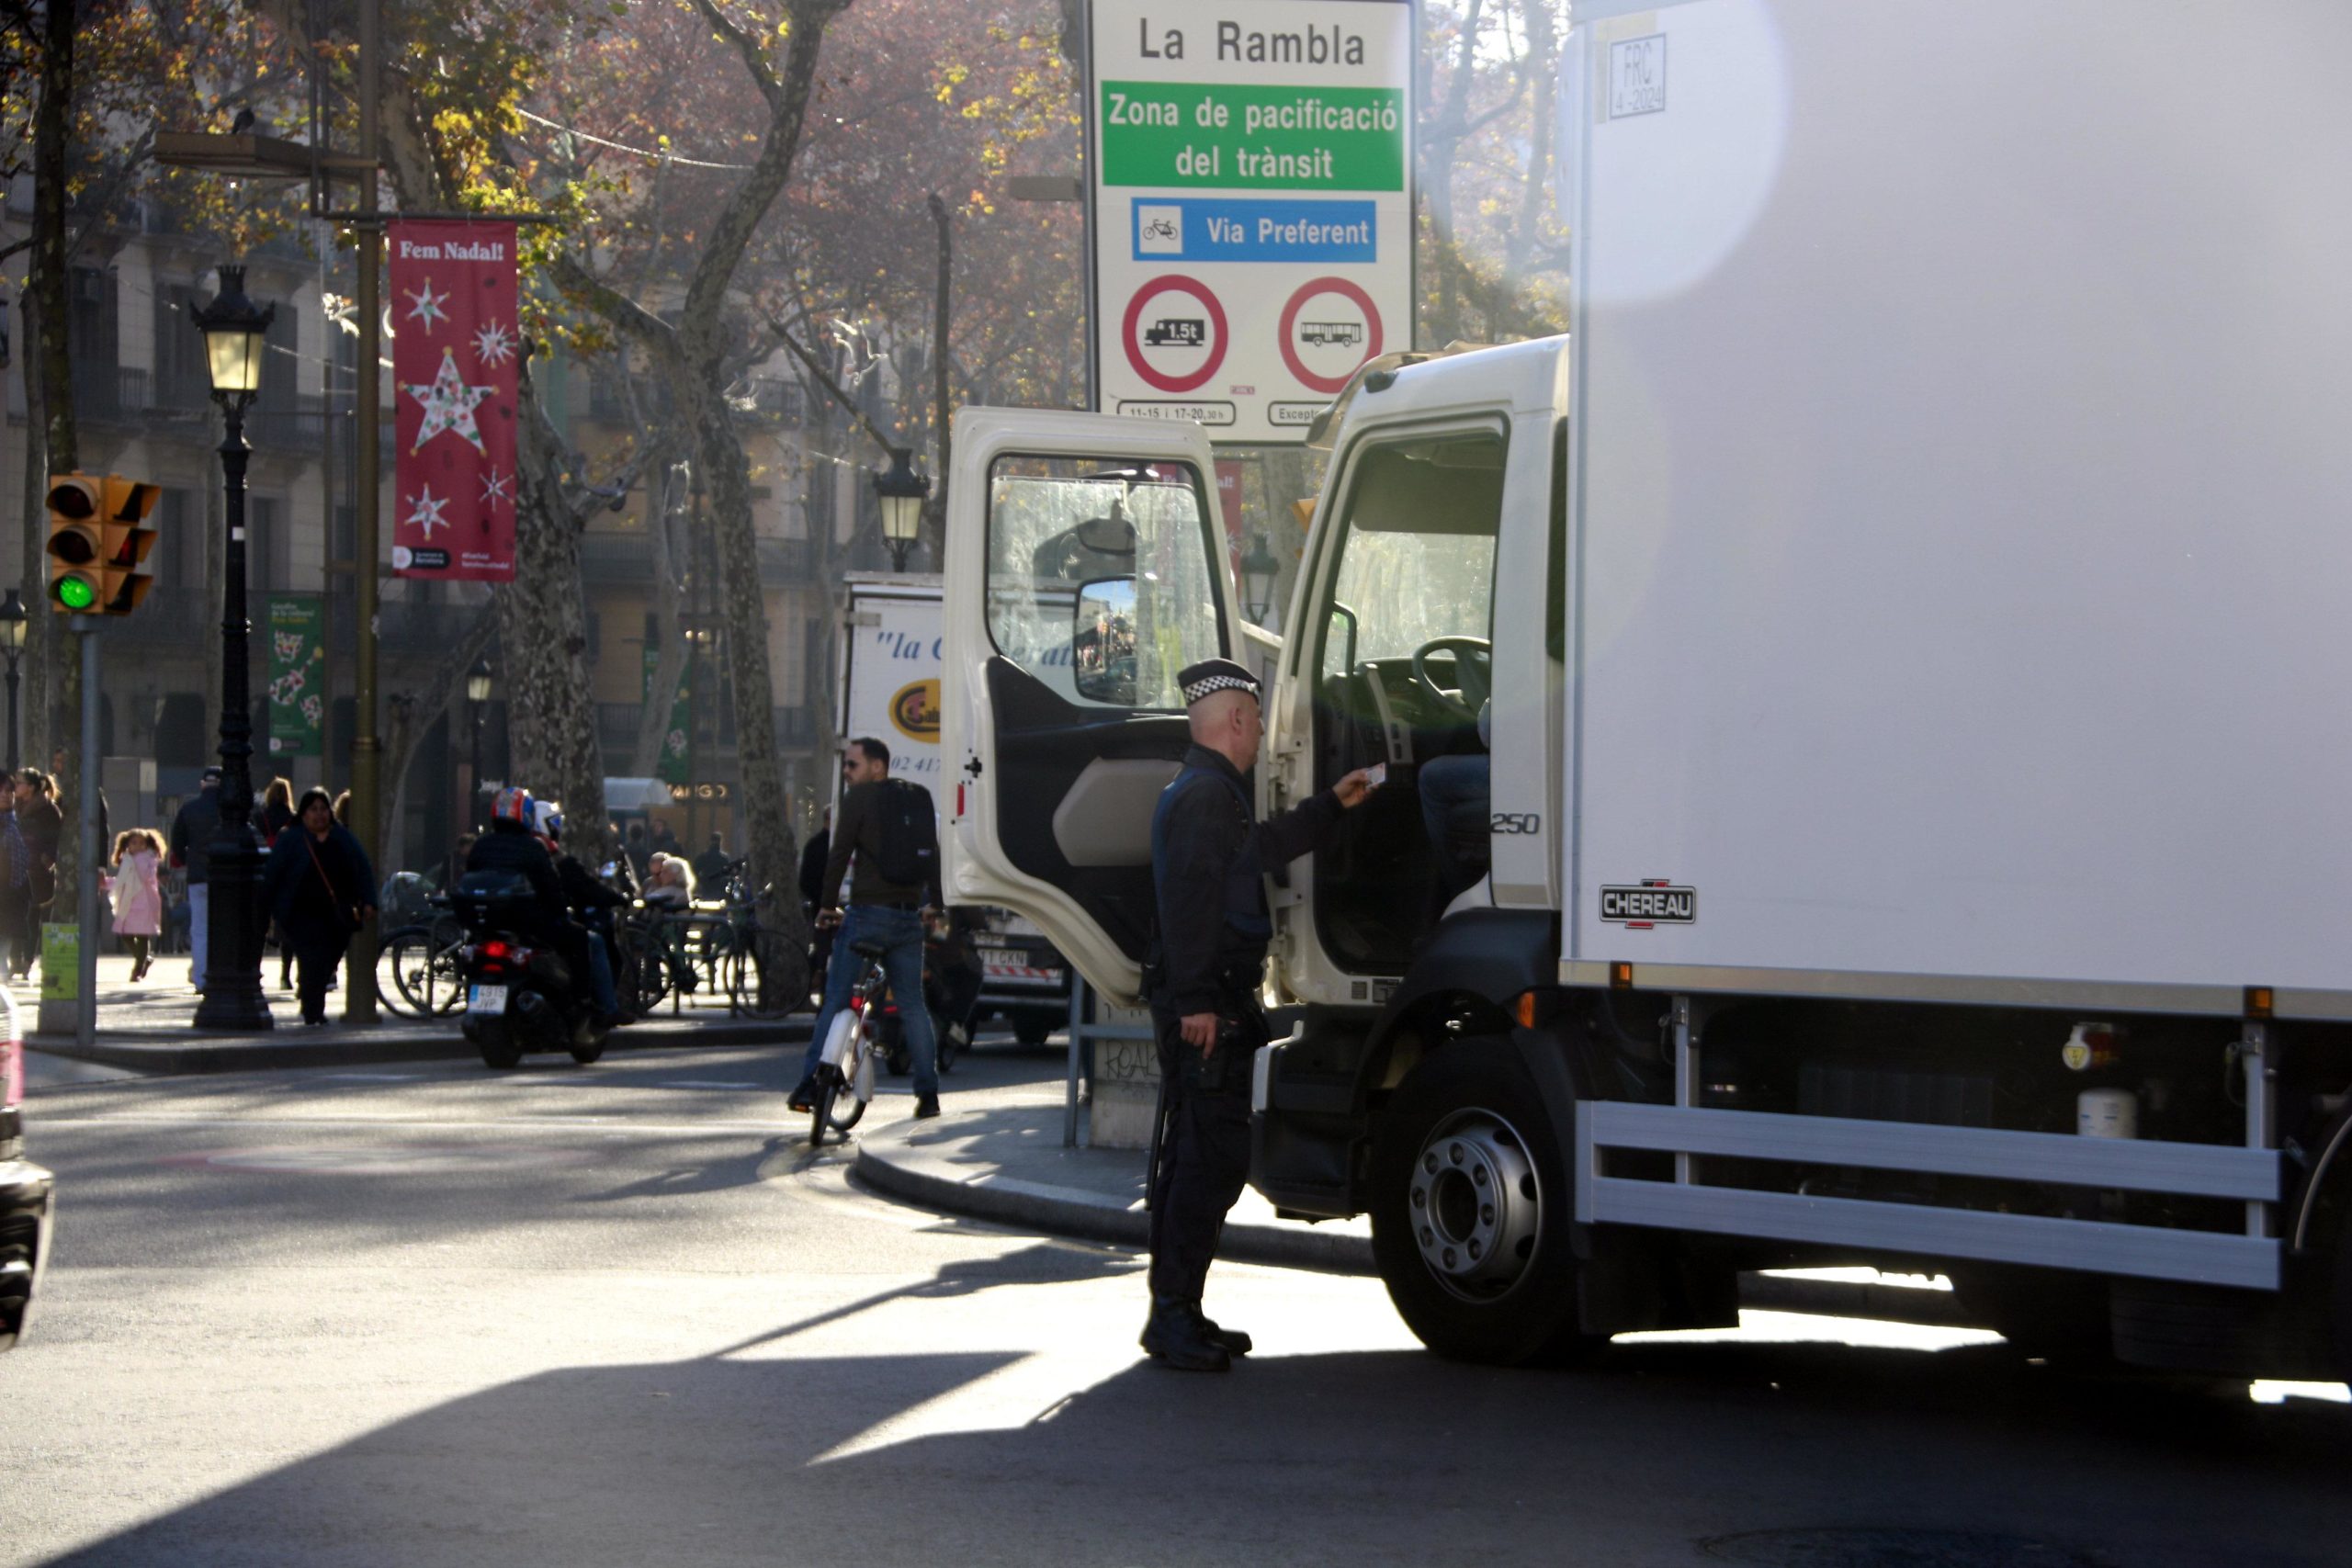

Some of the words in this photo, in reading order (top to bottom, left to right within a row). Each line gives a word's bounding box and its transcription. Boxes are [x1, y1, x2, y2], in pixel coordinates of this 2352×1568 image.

[1139, 17, 1184, 60] La
[1217, 20, 1364, 65] Rambla
[1623, 41, 1652, 87] FRC
[1108, 94, 1179, 126] Zona
[1195, 96, 1229, 127] de
[1245, 99, 1396, 135] pacificació
[1175, 145, 1220, 176] del
[1237, 147, 1334, 179] trànsit
[1206, 218, 1244, 243] Via
[1258, 219, 1369, 244] Preferent
[400, 241, 441, 259] Fem
[444, 242, 504, 261] Nadal!
[1130, 407, 1159, 418] 11-15
[1490, 813, 1540, 835] 250
[1603, 893, 1691, 917] CHEREAU
